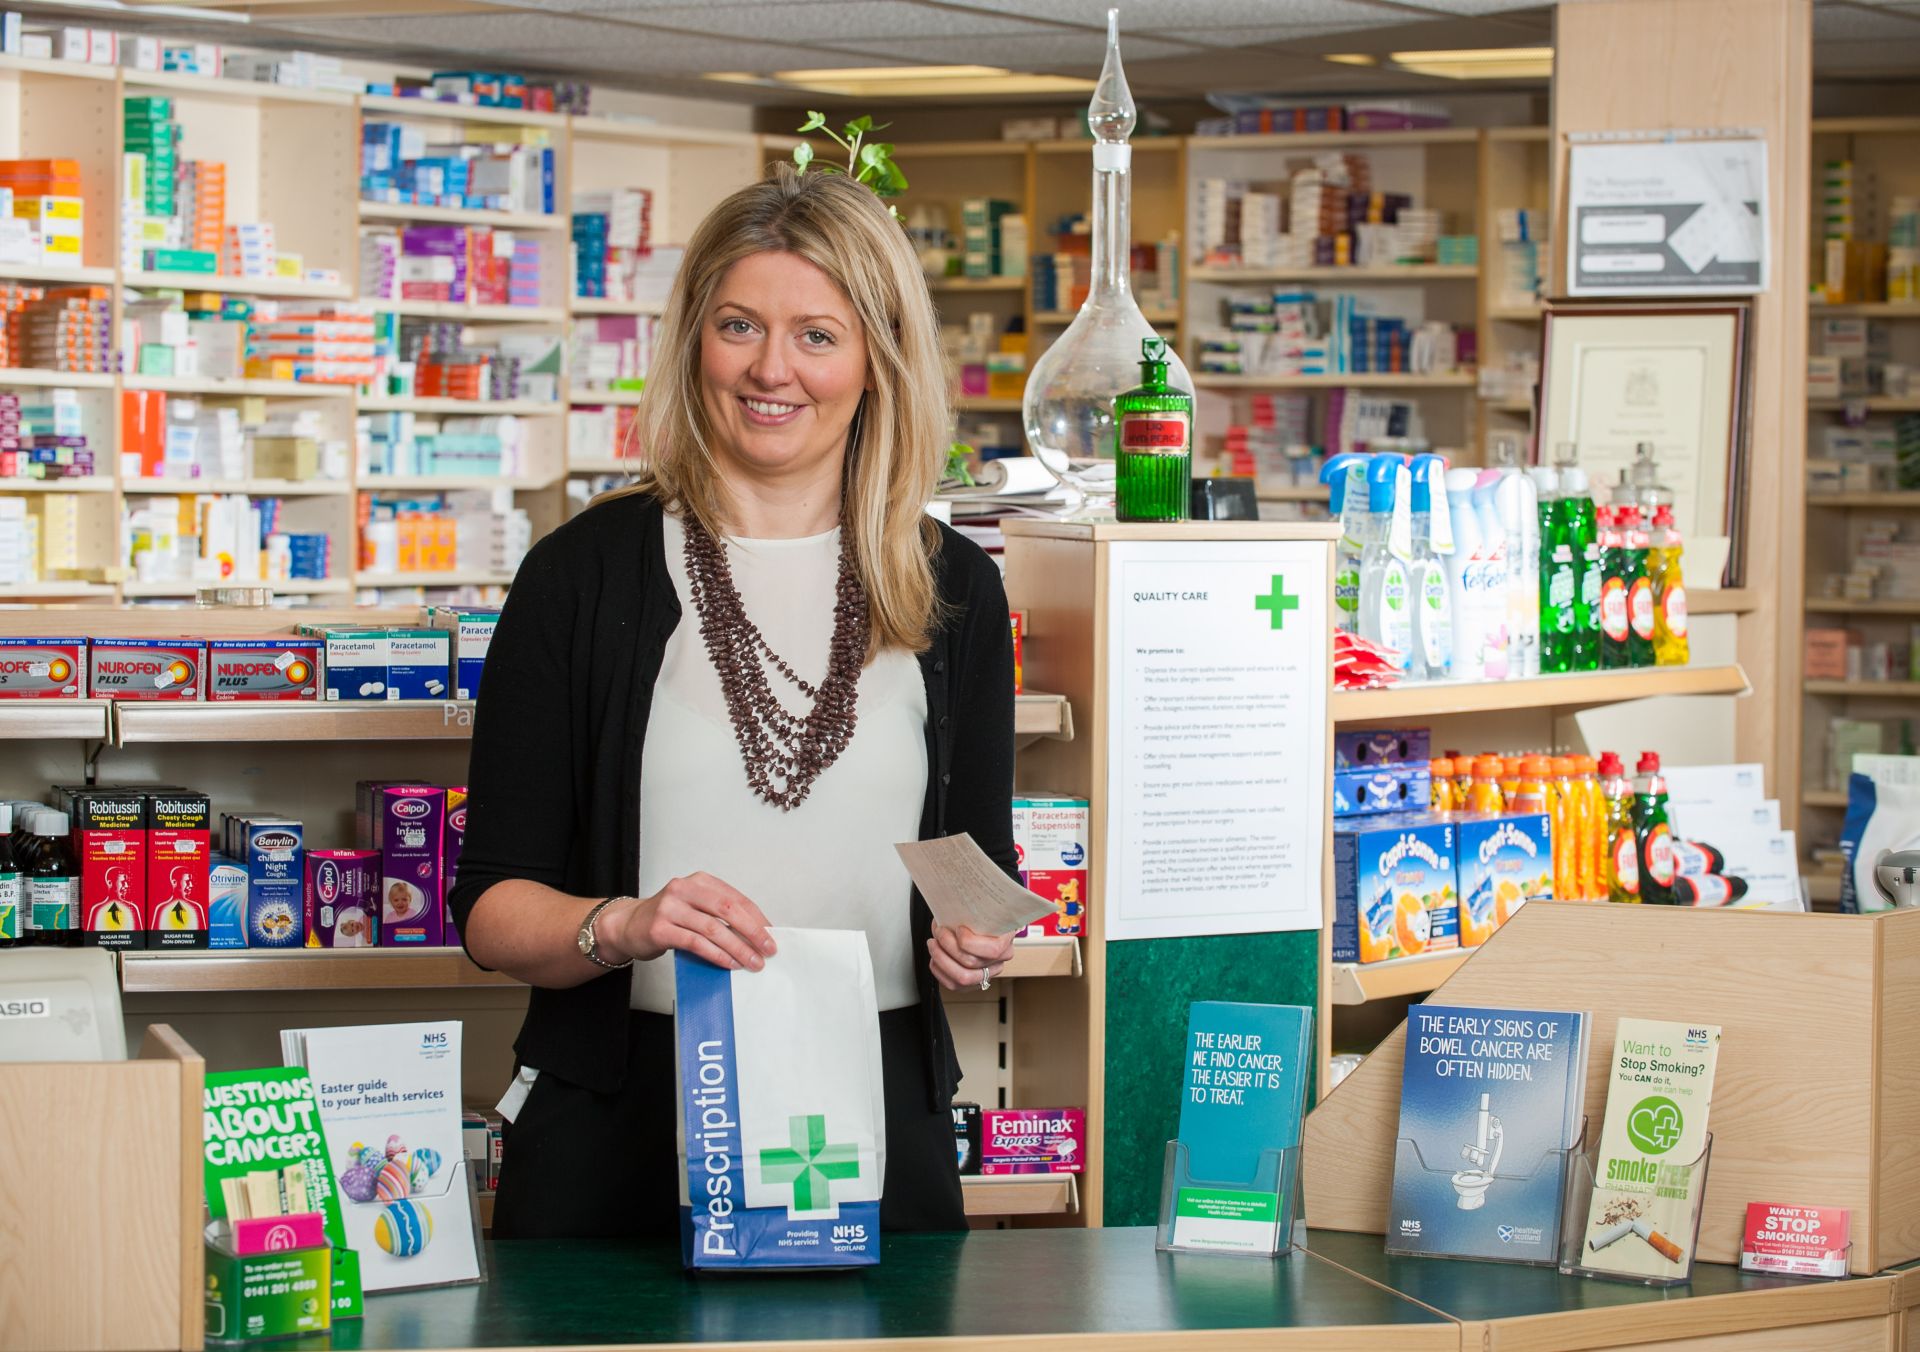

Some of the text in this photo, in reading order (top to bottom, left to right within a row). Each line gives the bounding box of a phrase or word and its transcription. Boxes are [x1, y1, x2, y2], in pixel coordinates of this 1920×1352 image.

[1133, 592, 1208, 602] QUALITY CARE
[461, 626, 494, 634] Paracet
[330, 643, 376, 651] Paracetamol
[391, 642, 436, 650] Paracetamol
[98, 661, 162, 675] NUROFEN
[218, 663, 281, 676] NUROFEN
[98, 676, 128, 684] PLUS
[218, 677, 248, 686] PLUS
[90, 801, 140, 814] Robitussin
[156, 801, 205, 814] Robitussin
[397, 804, 425, 815] Calpol
[1032, 811, 1085, 820] Paracetamol
[1032, 822, 1081, 830] Suspension
[258, 837, 294, 847] Benylin
[265, 863, 287, 872] Night
[211, 875, 246, 883] Otrivine
[323, 867, 333, 898] Calpol
[1419, 1015, 1559, 1040] THE EARLY SIGNS OF
[1687, 1028, 1707, 1039] NHS
[424, 1033, 447, 1044] NHS
[1195, 1032, 1261, 1051] THE EARLIER
[1420, 1037, 1553, 1061] BOWEL CANCER ARE
[1623, 1040, 1672, 1057] Want to
[1193, 1051, 1284, 1073] WE FIND CANCER,
[1620, 1057, 1705, 1077] Stop Smoking?
[1435, 1059, 1533, 1081] OFTEN HIDDEN.
[1191, 1069, 1280, 1088] THE EASIER IT IS
[1618, 1073, 1672, 1086] You CAN do it,
[204, 1077, 314, 1109] UESTIONS
[321, 1079, 388, 1094] Easter guide
[1679, 1087, 1693, 1096] help
[322, 1089, 444, 1110] to your health services
[1190, 1087, 1245, 1105] TO TREAT.
[204, 1100, 315, 1142] ABOUT
[992, 1115, 1073, 1135] Feminax
[692, 1040, 736, 1256] Prescription
[992, 1135, 1041, 1148] Express
[205, 1131, 321, 1166] CANCER?
[1769, 1207, 1818, 1218] WANT TO
[1401, 1219, 1421, 1229] NHS
[1514, 1226, 1543, 1234] healthier
[1765, 1216, 1821, 1233] STOP
[787, 1230, 819, 1239] Providing
[833, 1225, 865, 1238] NHS
[1514, 1233, 1541, 1241] scotland
[1756, 1230, 1827, 1245] SMOKING?
[793, 1238, 819, 1246] services
[834, 1244, 865, 1252] SCOTLAND
[244, 1286, 269, 1298] 0141
[271, 1283, 289, 1295] 201
